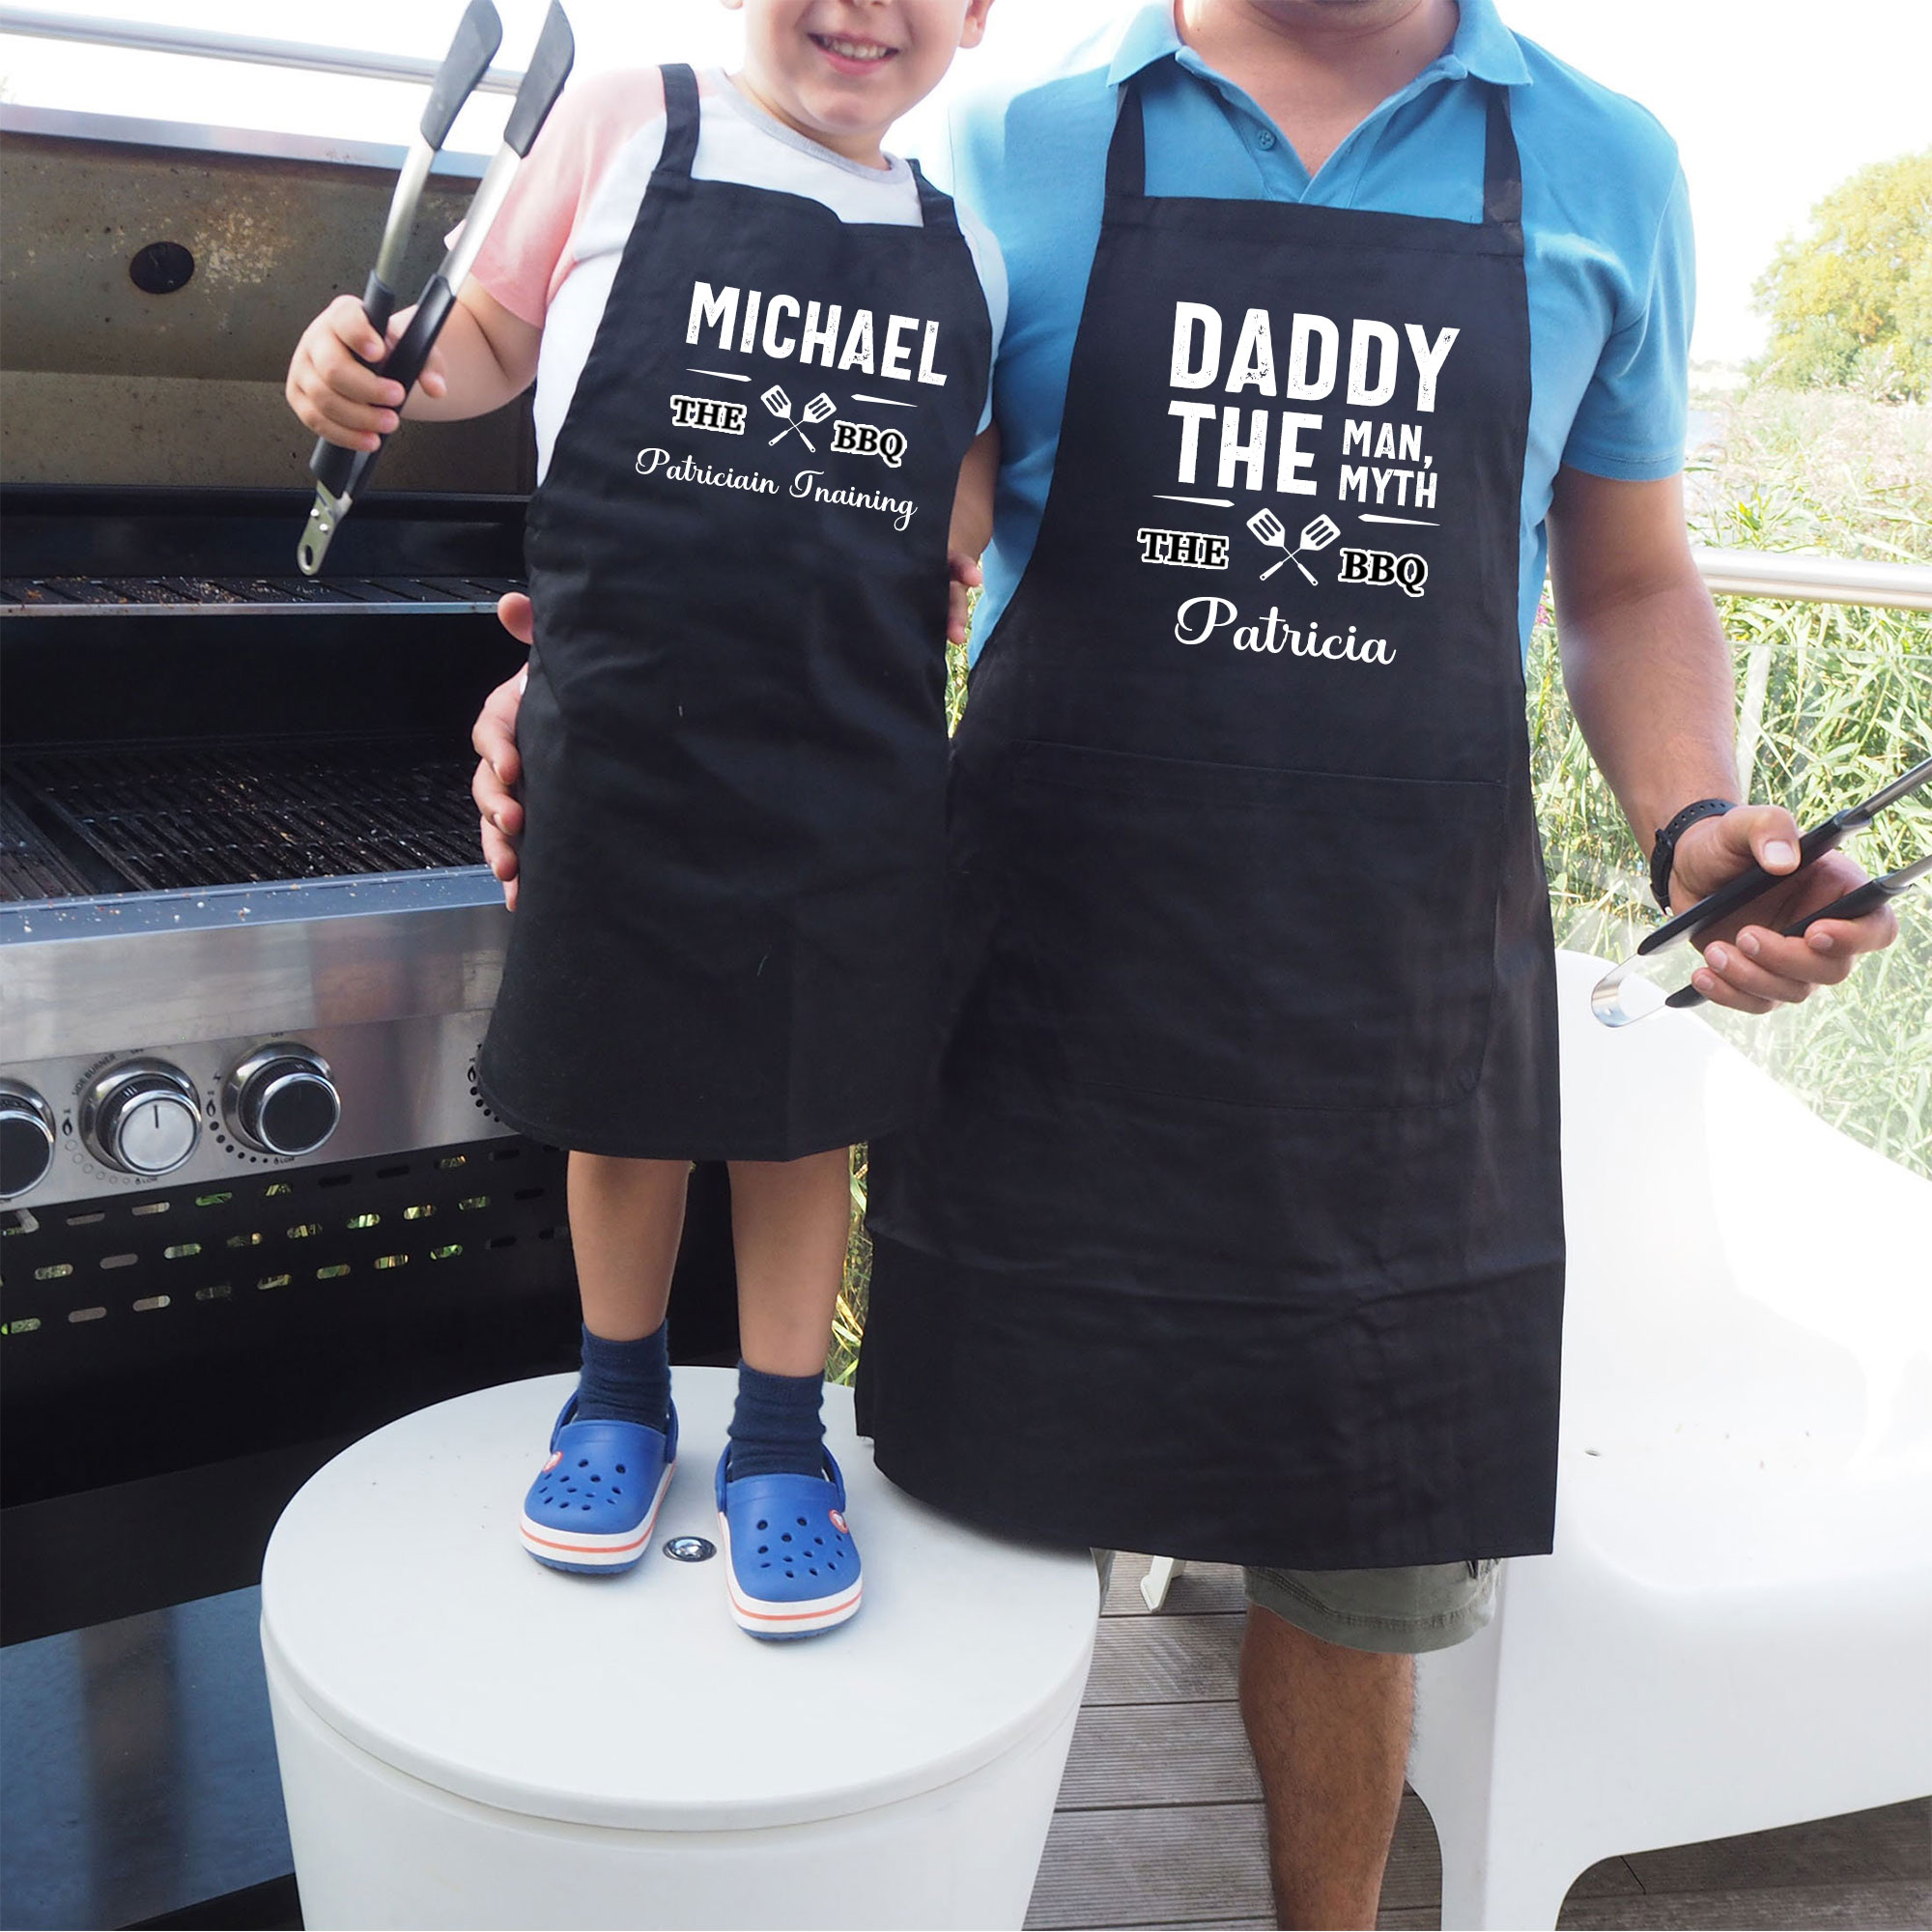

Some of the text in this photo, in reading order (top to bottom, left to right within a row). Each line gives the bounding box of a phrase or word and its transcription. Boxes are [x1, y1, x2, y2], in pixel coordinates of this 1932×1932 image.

[685, 280, 948, 386] MICHAEL
[1169, 300, 1461, 413] DADDY
[670, 395, 907, 469] THE BBQ
[1167, 400, 1323, 497] THE
[1342, 418, 1434, 469] MAN,
[635, 447, 781, 495] Patriciain
[1338, 464, 1438, 509] MYTH
[1137, 528, 1429, 598] THE BBQ
[1174, 596, 1397, 666] Patricia
